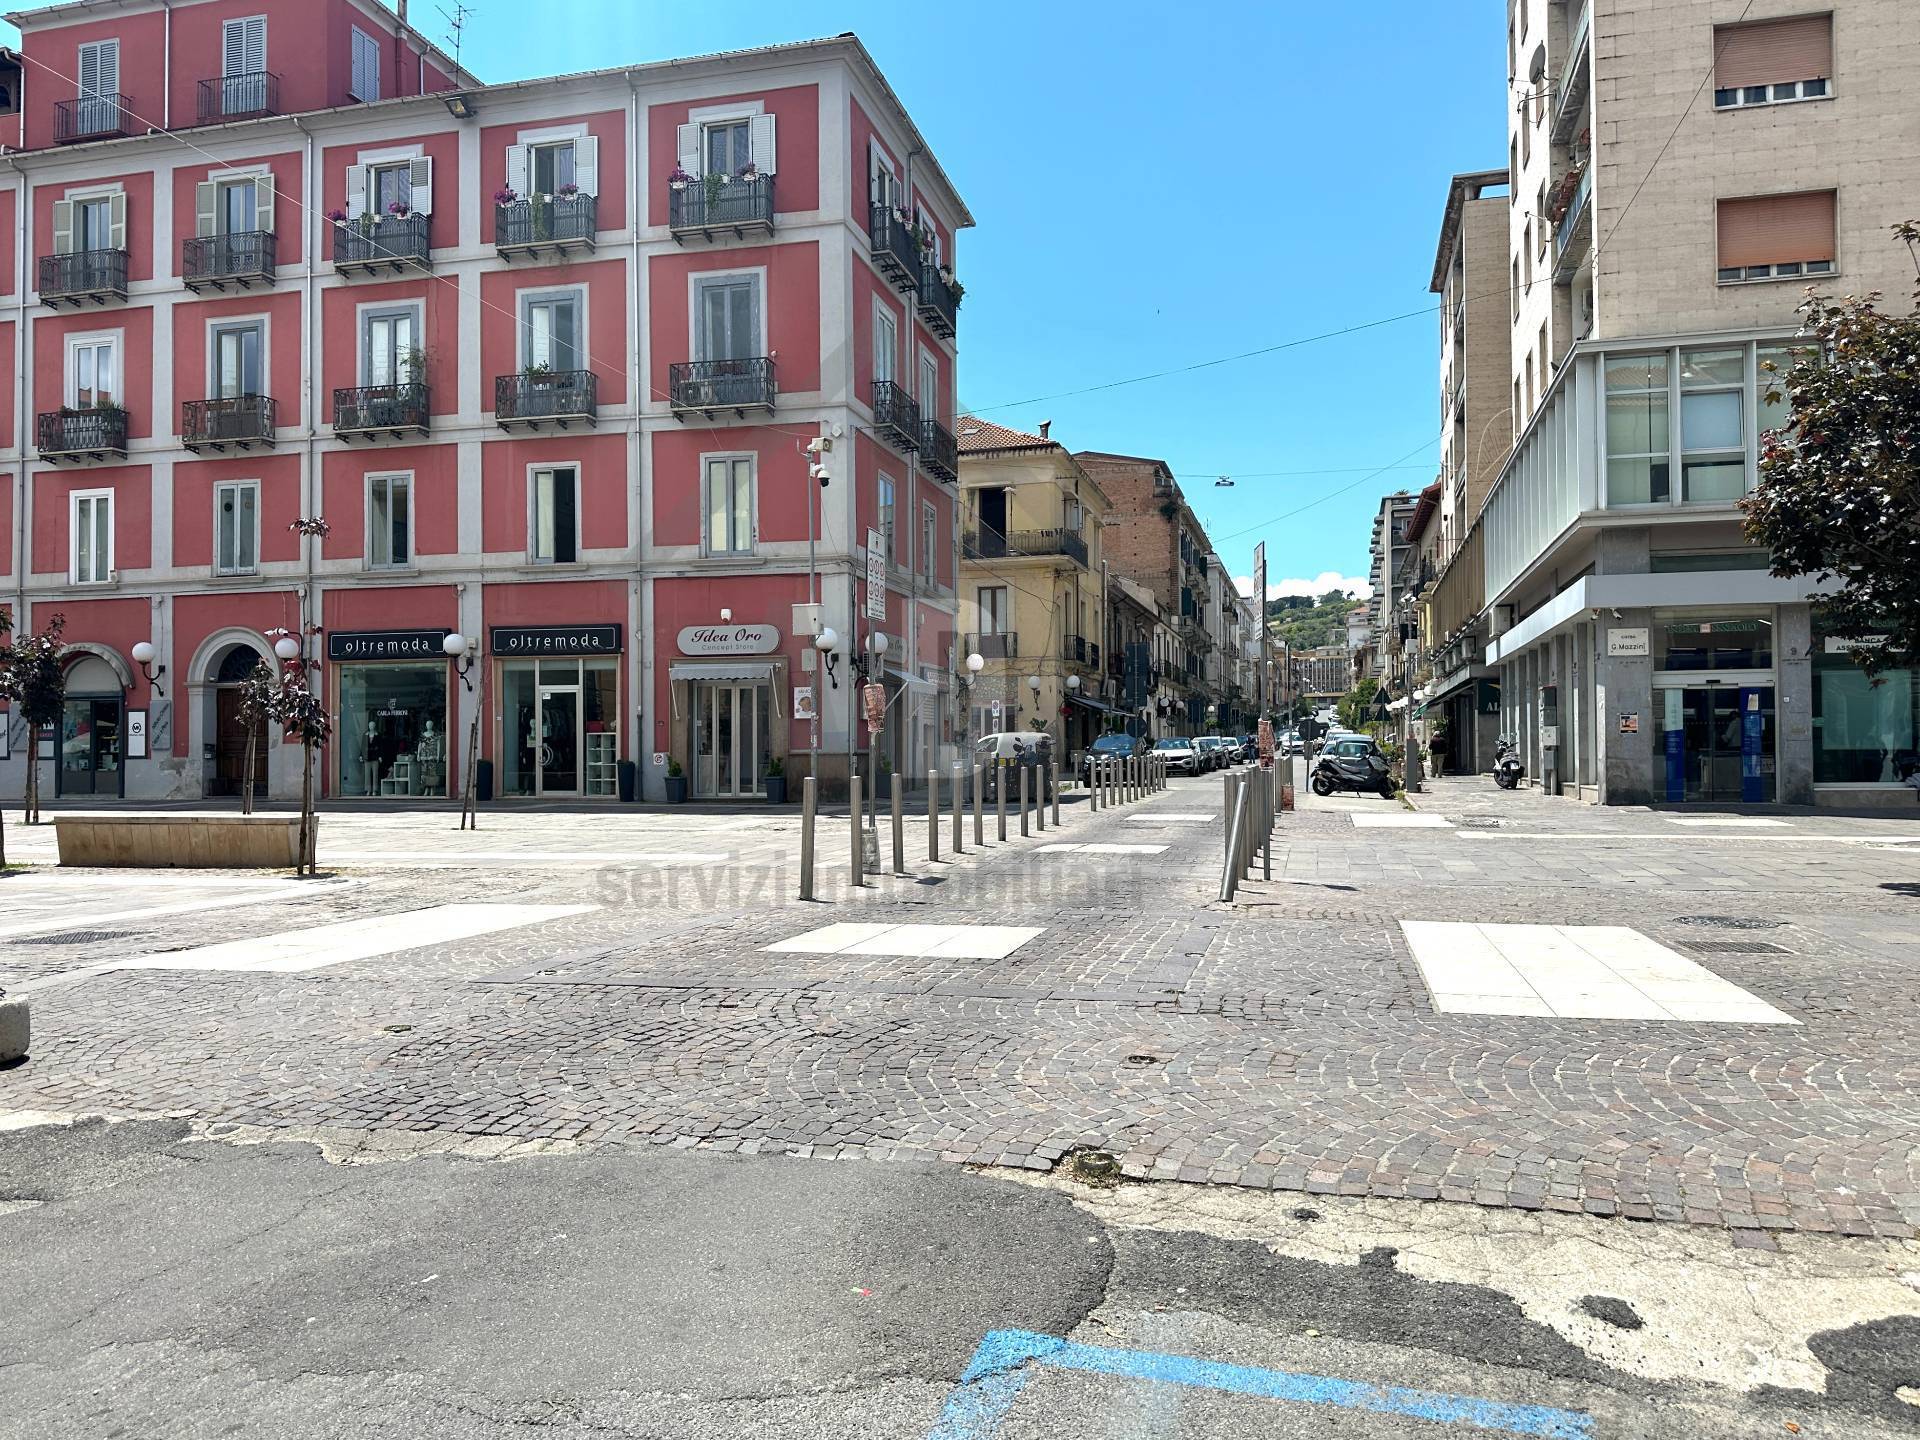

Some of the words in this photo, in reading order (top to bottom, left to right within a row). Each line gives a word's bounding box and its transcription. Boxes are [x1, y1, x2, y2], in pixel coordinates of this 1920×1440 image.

[509, 633, 599, 647] oltremoda
[691, 628, 728, 643] Idea
[735, 628, 762, 642] Oro
[345, 638, 429, 651] oltremoda
